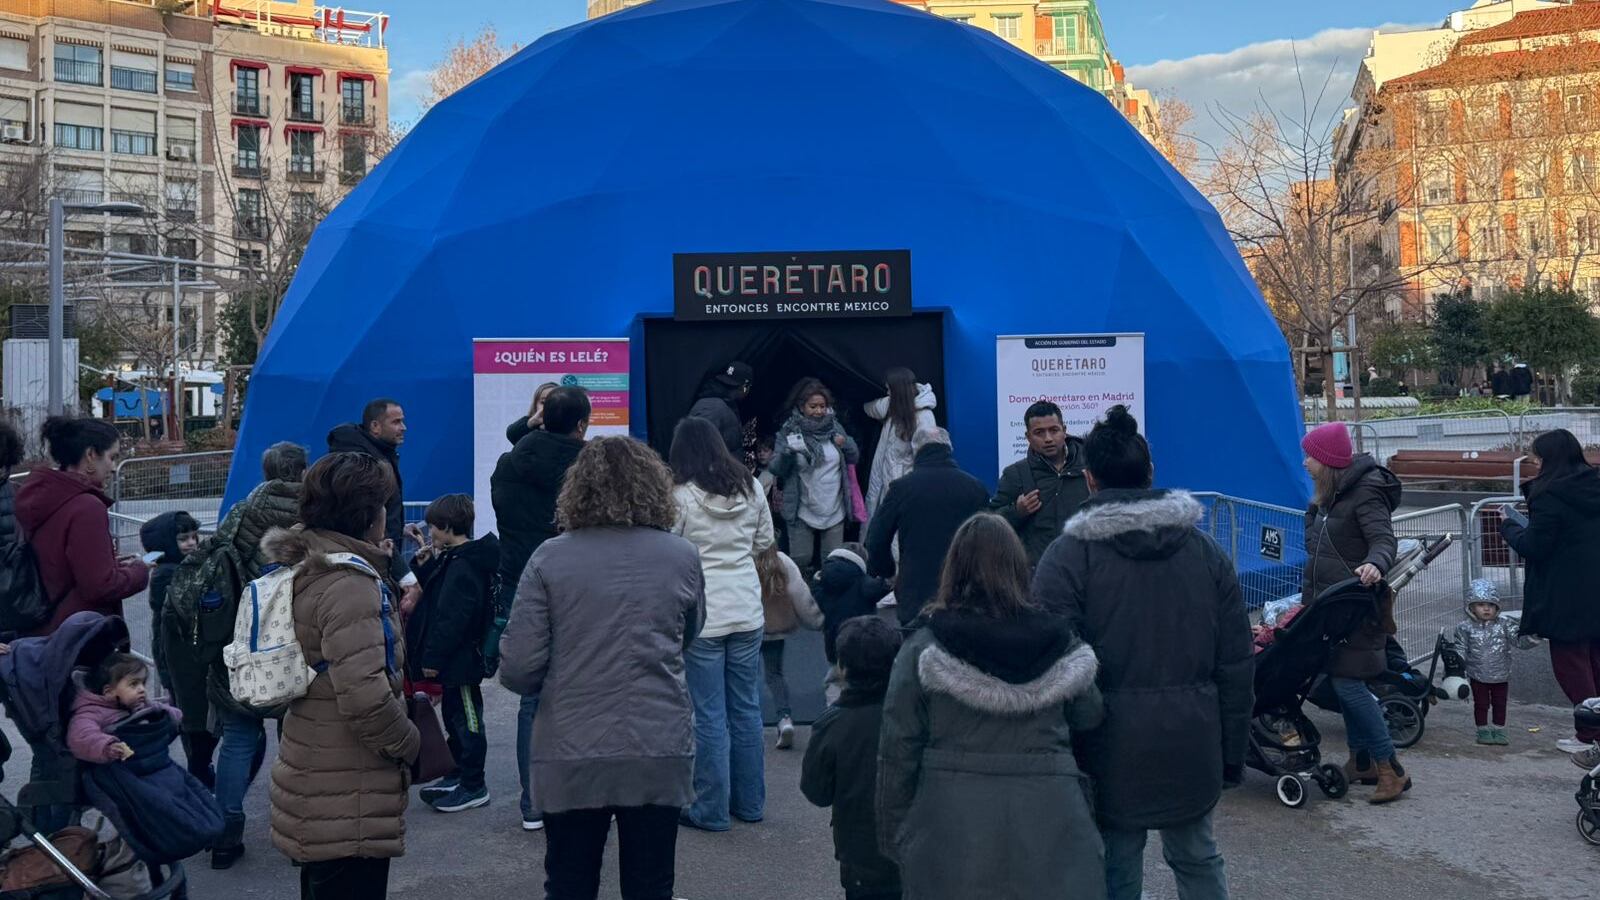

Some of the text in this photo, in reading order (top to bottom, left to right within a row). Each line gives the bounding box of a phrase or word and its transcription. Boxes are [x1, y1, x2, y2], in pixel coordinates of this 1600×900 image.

[705, 301, 889, 314] ENTONCES ENCONTRE MEXICO
[494, 347, 609, 366] ¿QUIÉN ES LELÉ?
[1008, 394, 1037, 403] Domo
[1039, 393, 1086, 403] Querétaro
[1102, 392, 1135, 401] Madrid
[1264, 529, 1278, 544] AMS
